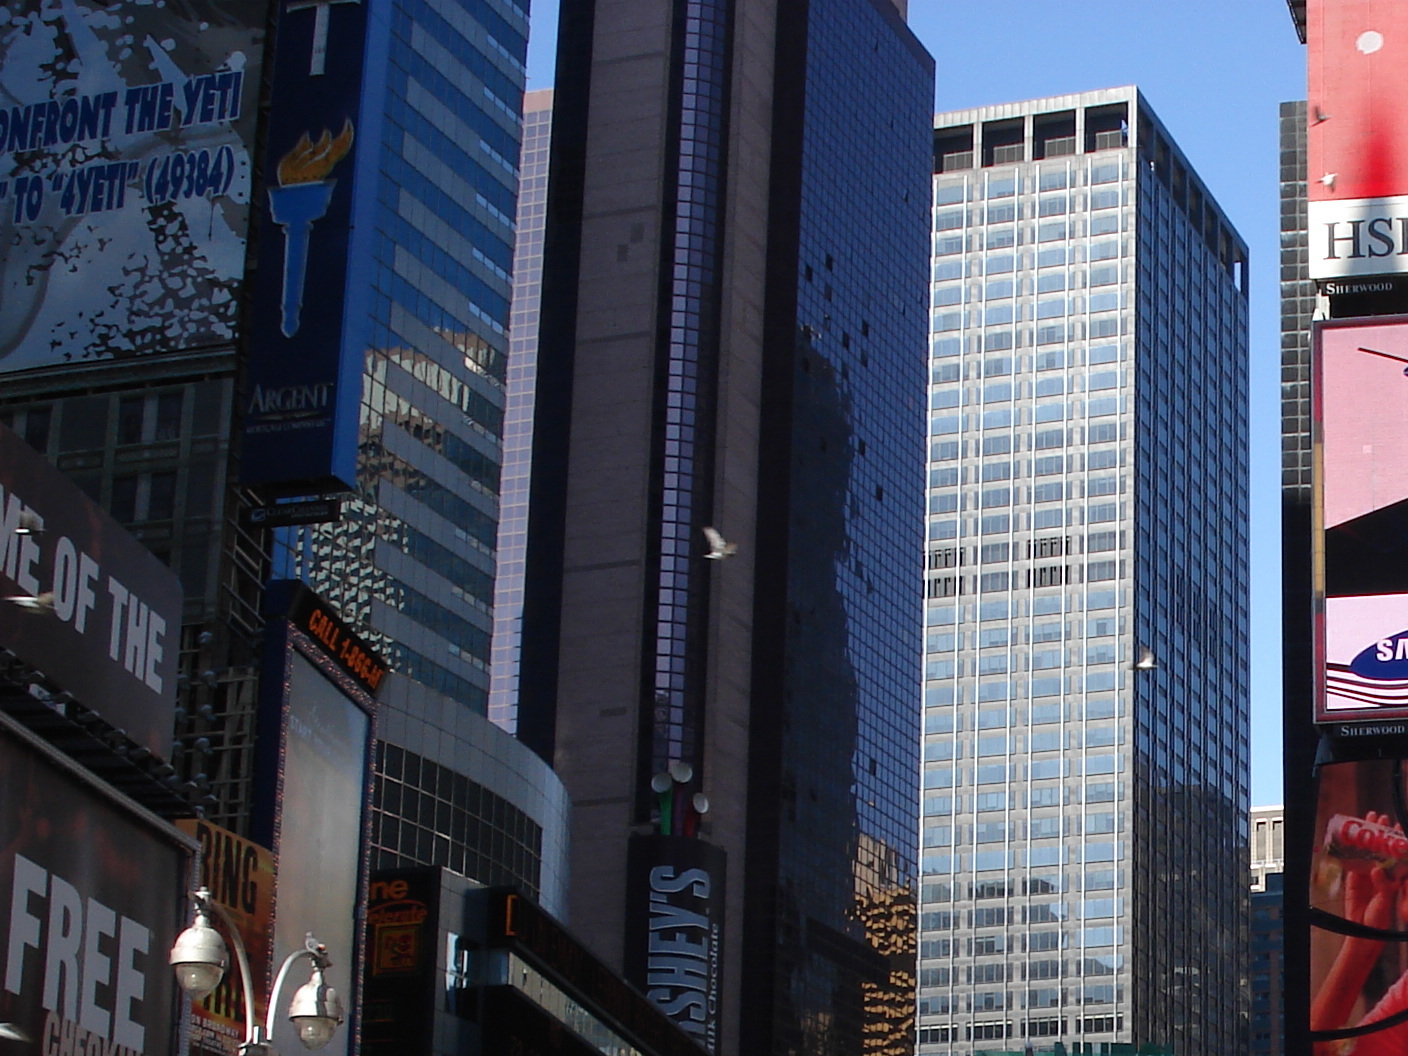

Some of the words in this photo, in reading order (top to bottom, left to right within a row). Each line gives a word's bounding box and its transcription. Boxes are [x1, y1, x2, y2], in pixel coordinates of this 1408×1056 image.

[124, 82, 174, 135] THE
[180, 71, 244, 129] YETI
[14, 175, 44, 224] TO
[144, 145, 235, 205] (49384)
[1326, 281, 1394, 296] SHERWOOD
[248, 383, 329, 415] ARGENT
[52, 535, 99, 635] OF
[108, 575, 166, 696] THE
[308, 608, 340, 652] CALL
[1340, 723, 1406, 737] SHERWOOD
[5, 852, 150, 1055] FREE
